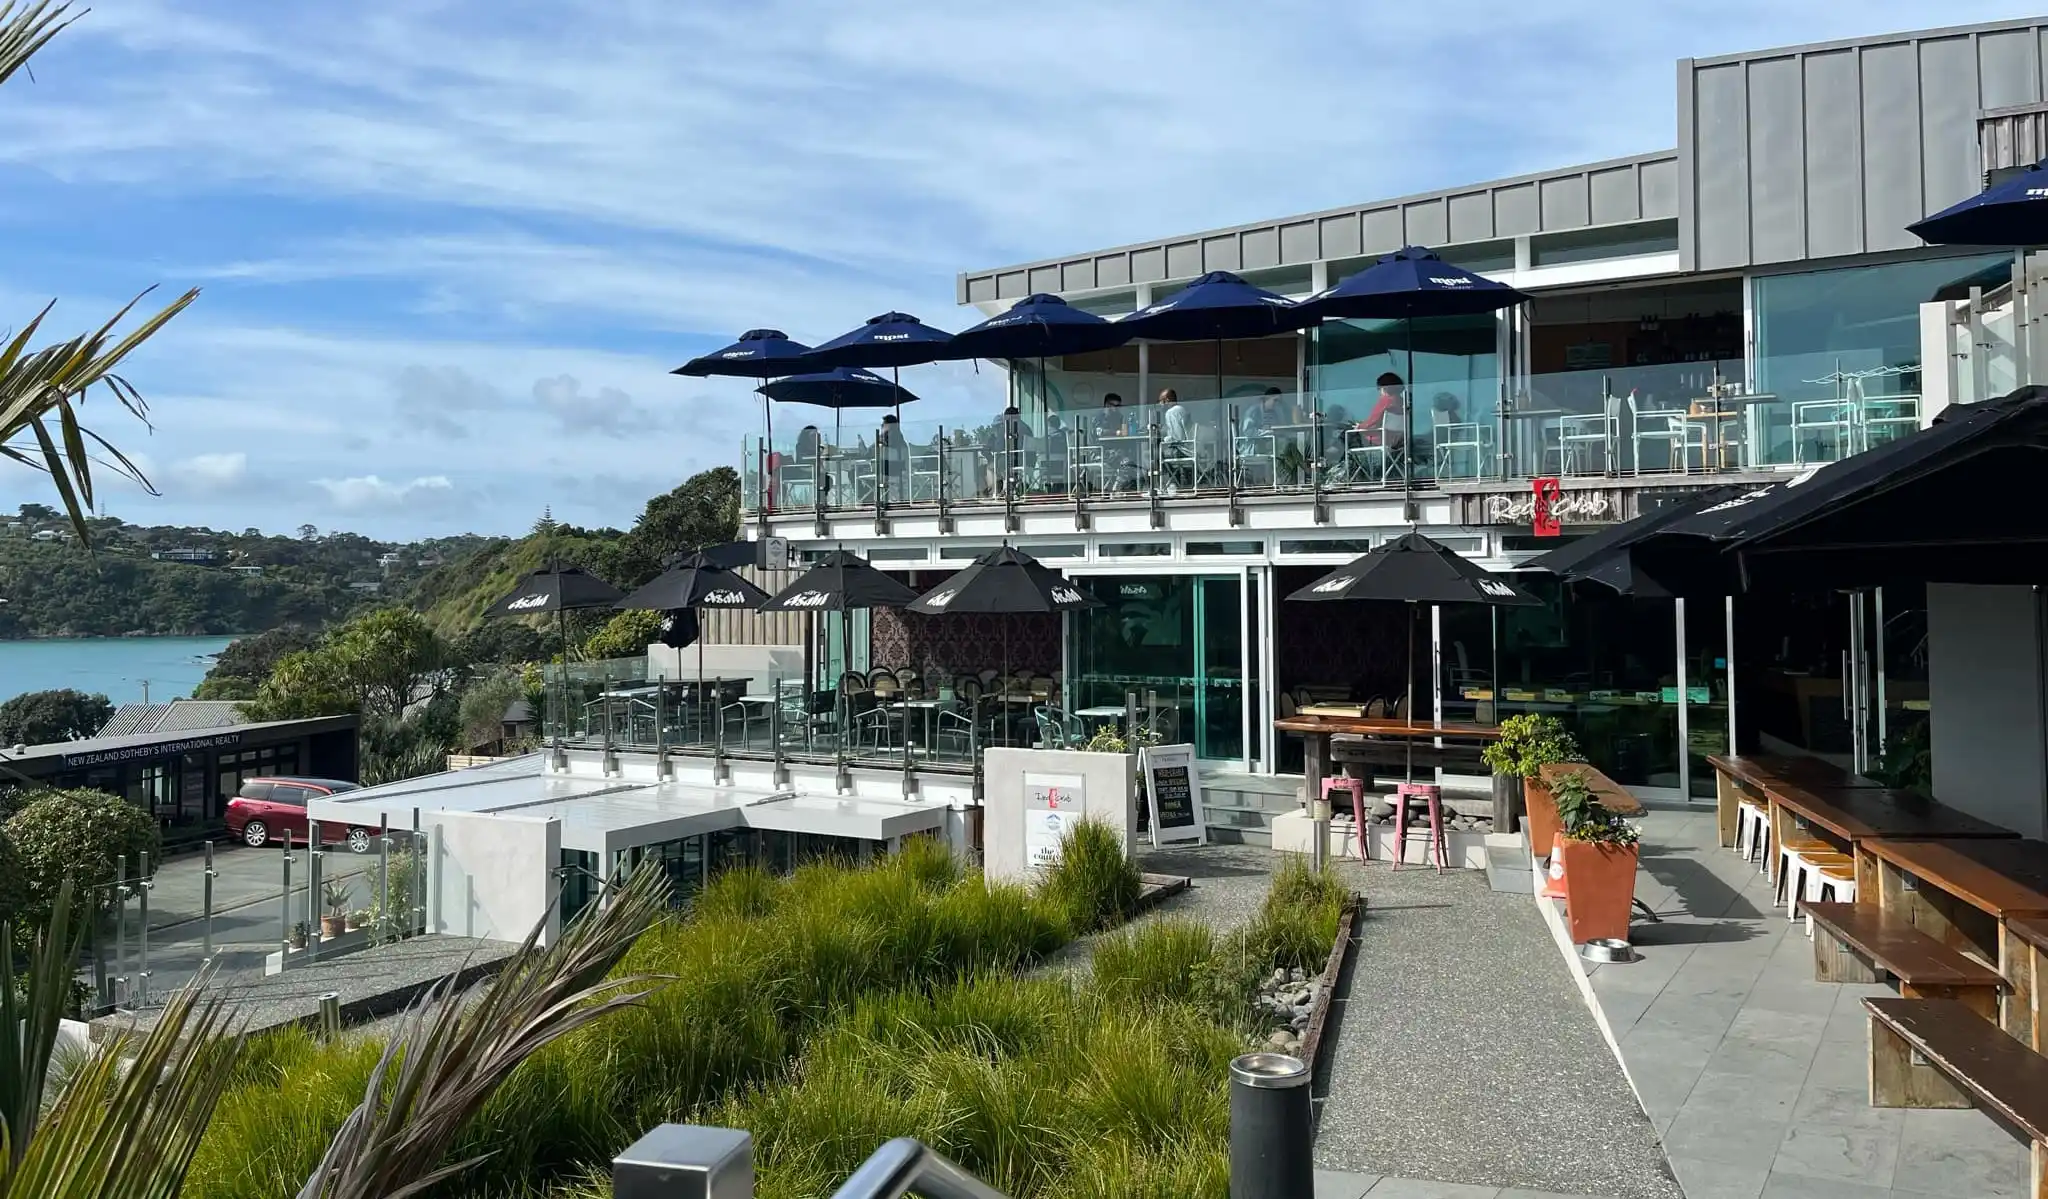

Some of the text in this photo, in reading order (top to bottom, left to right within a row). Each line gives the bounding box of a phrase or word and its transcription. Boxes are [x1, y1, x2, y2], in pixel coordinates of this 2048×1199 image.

[1485, 491, 1609, 520] Red Crab
[507, 593, 550, 610] Asahi
[703, 591, 746, 604] Asahi
[783, 592, 830, 607] Asahi
[67, 734, 240, 767] NEW ZEALAND SOTHEBY'S INTERNATIONAL REALTY
